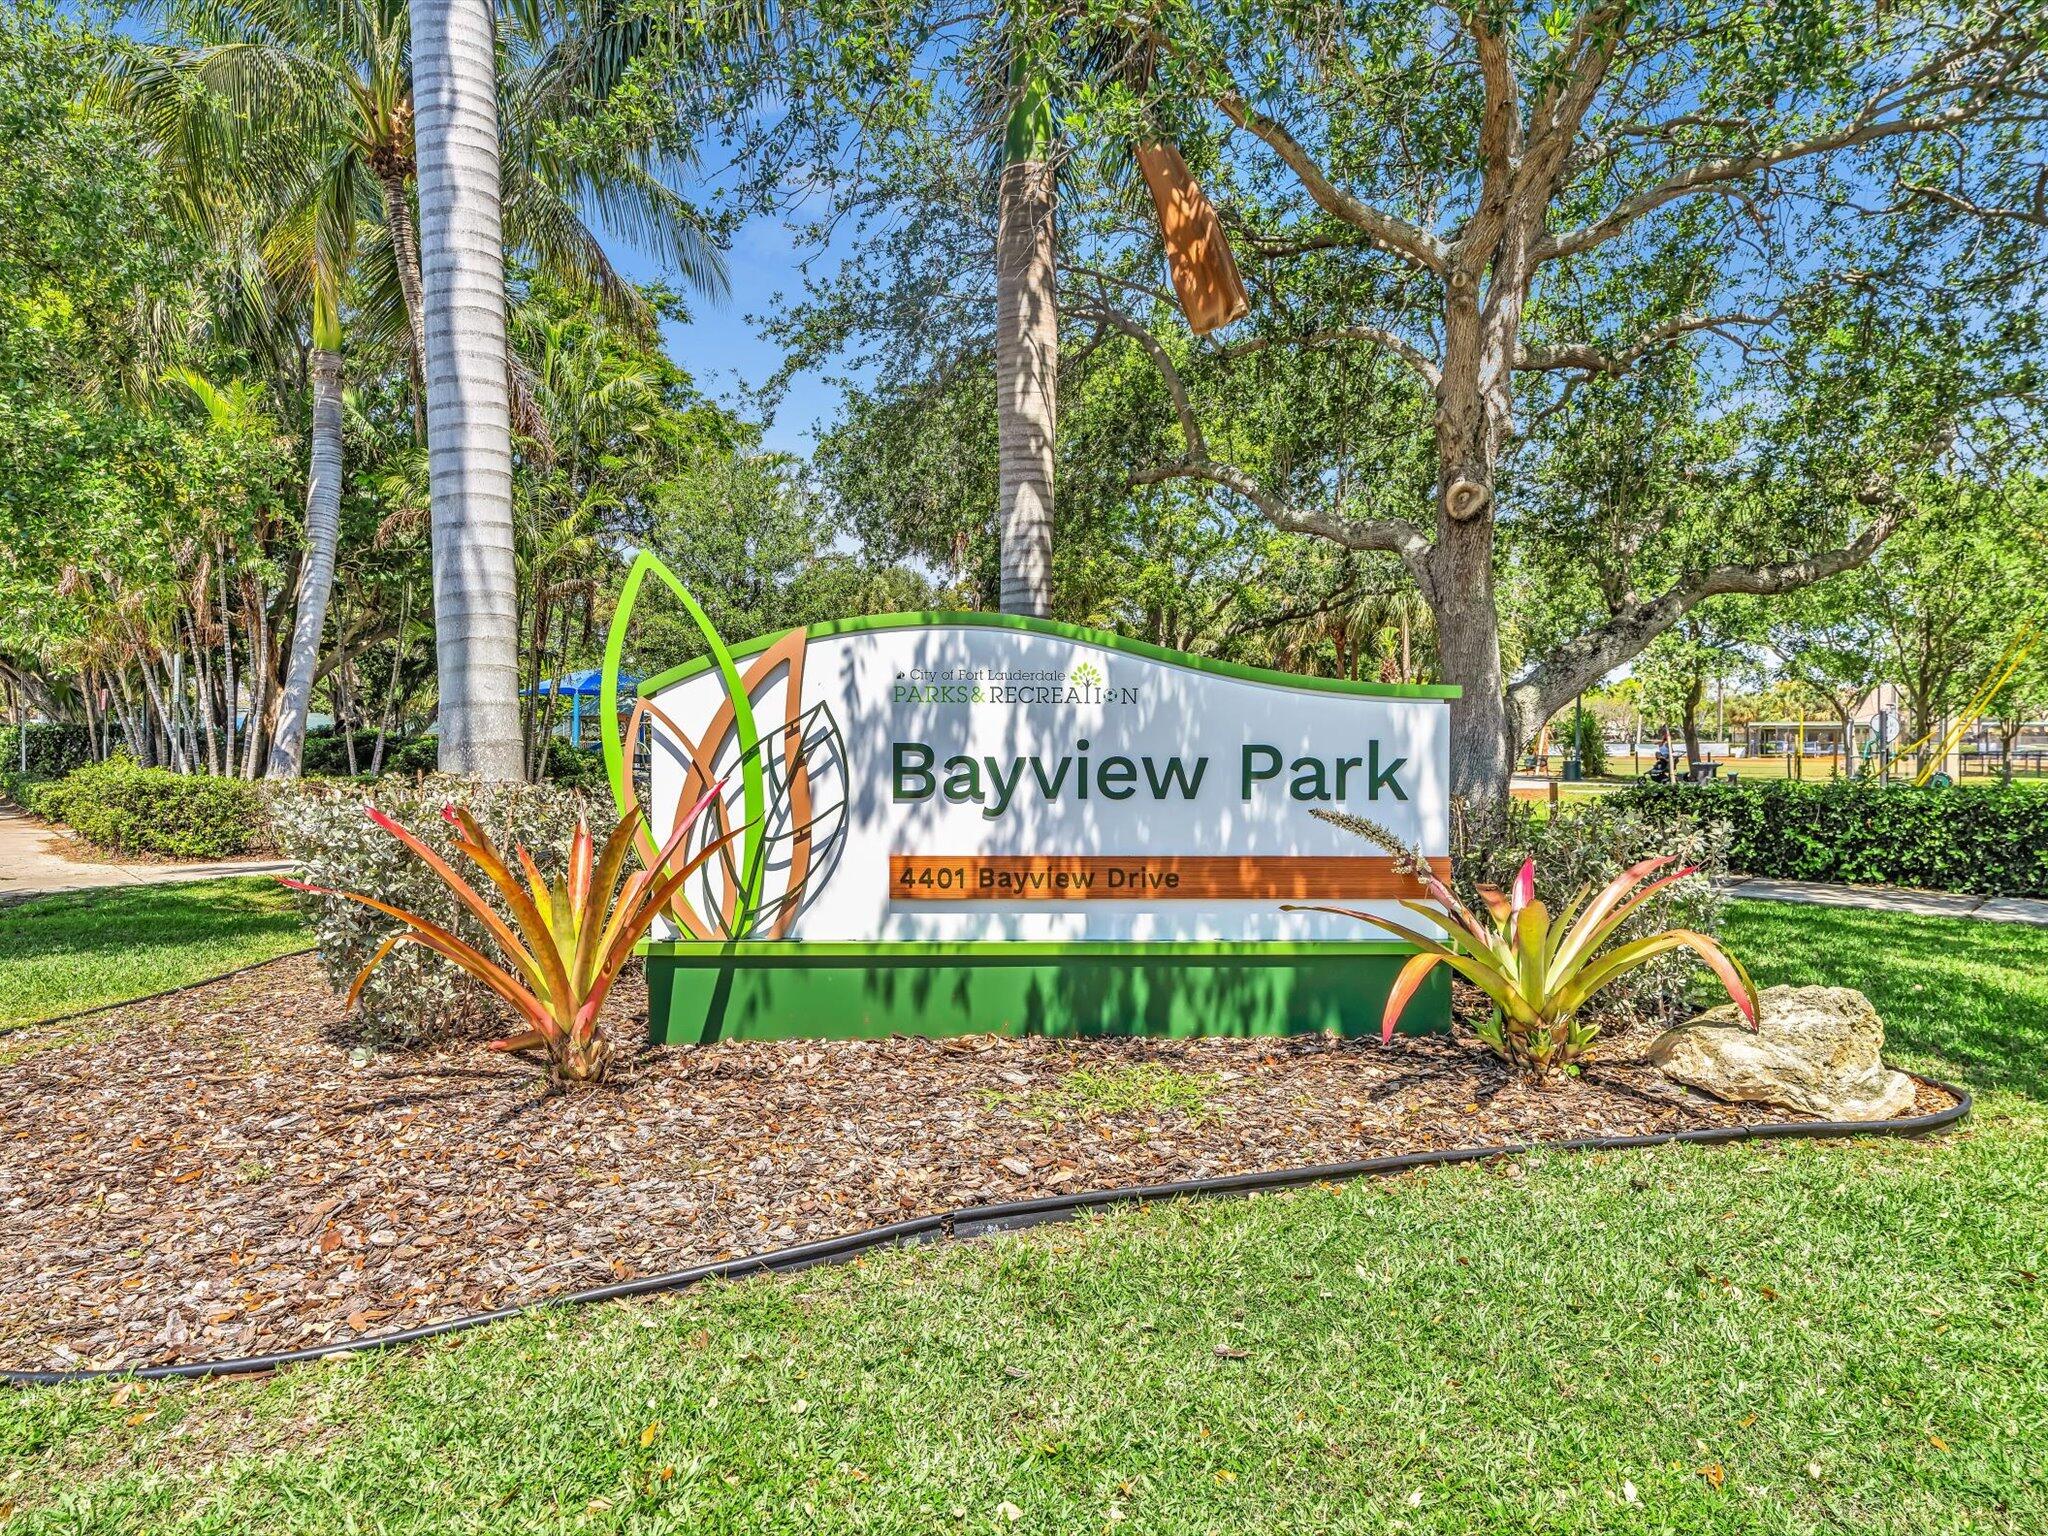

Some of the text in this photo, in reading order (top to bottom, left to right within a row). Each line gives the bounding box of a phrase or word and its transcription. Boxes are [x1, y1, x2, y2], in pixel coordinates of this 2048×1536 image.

[909, 668, 1066, 683] City of Fort Lauderdale
[892, 739, 1408, 818] Bayview Park
[899, 865, 1180, 893] 4401 Bayview Drive
